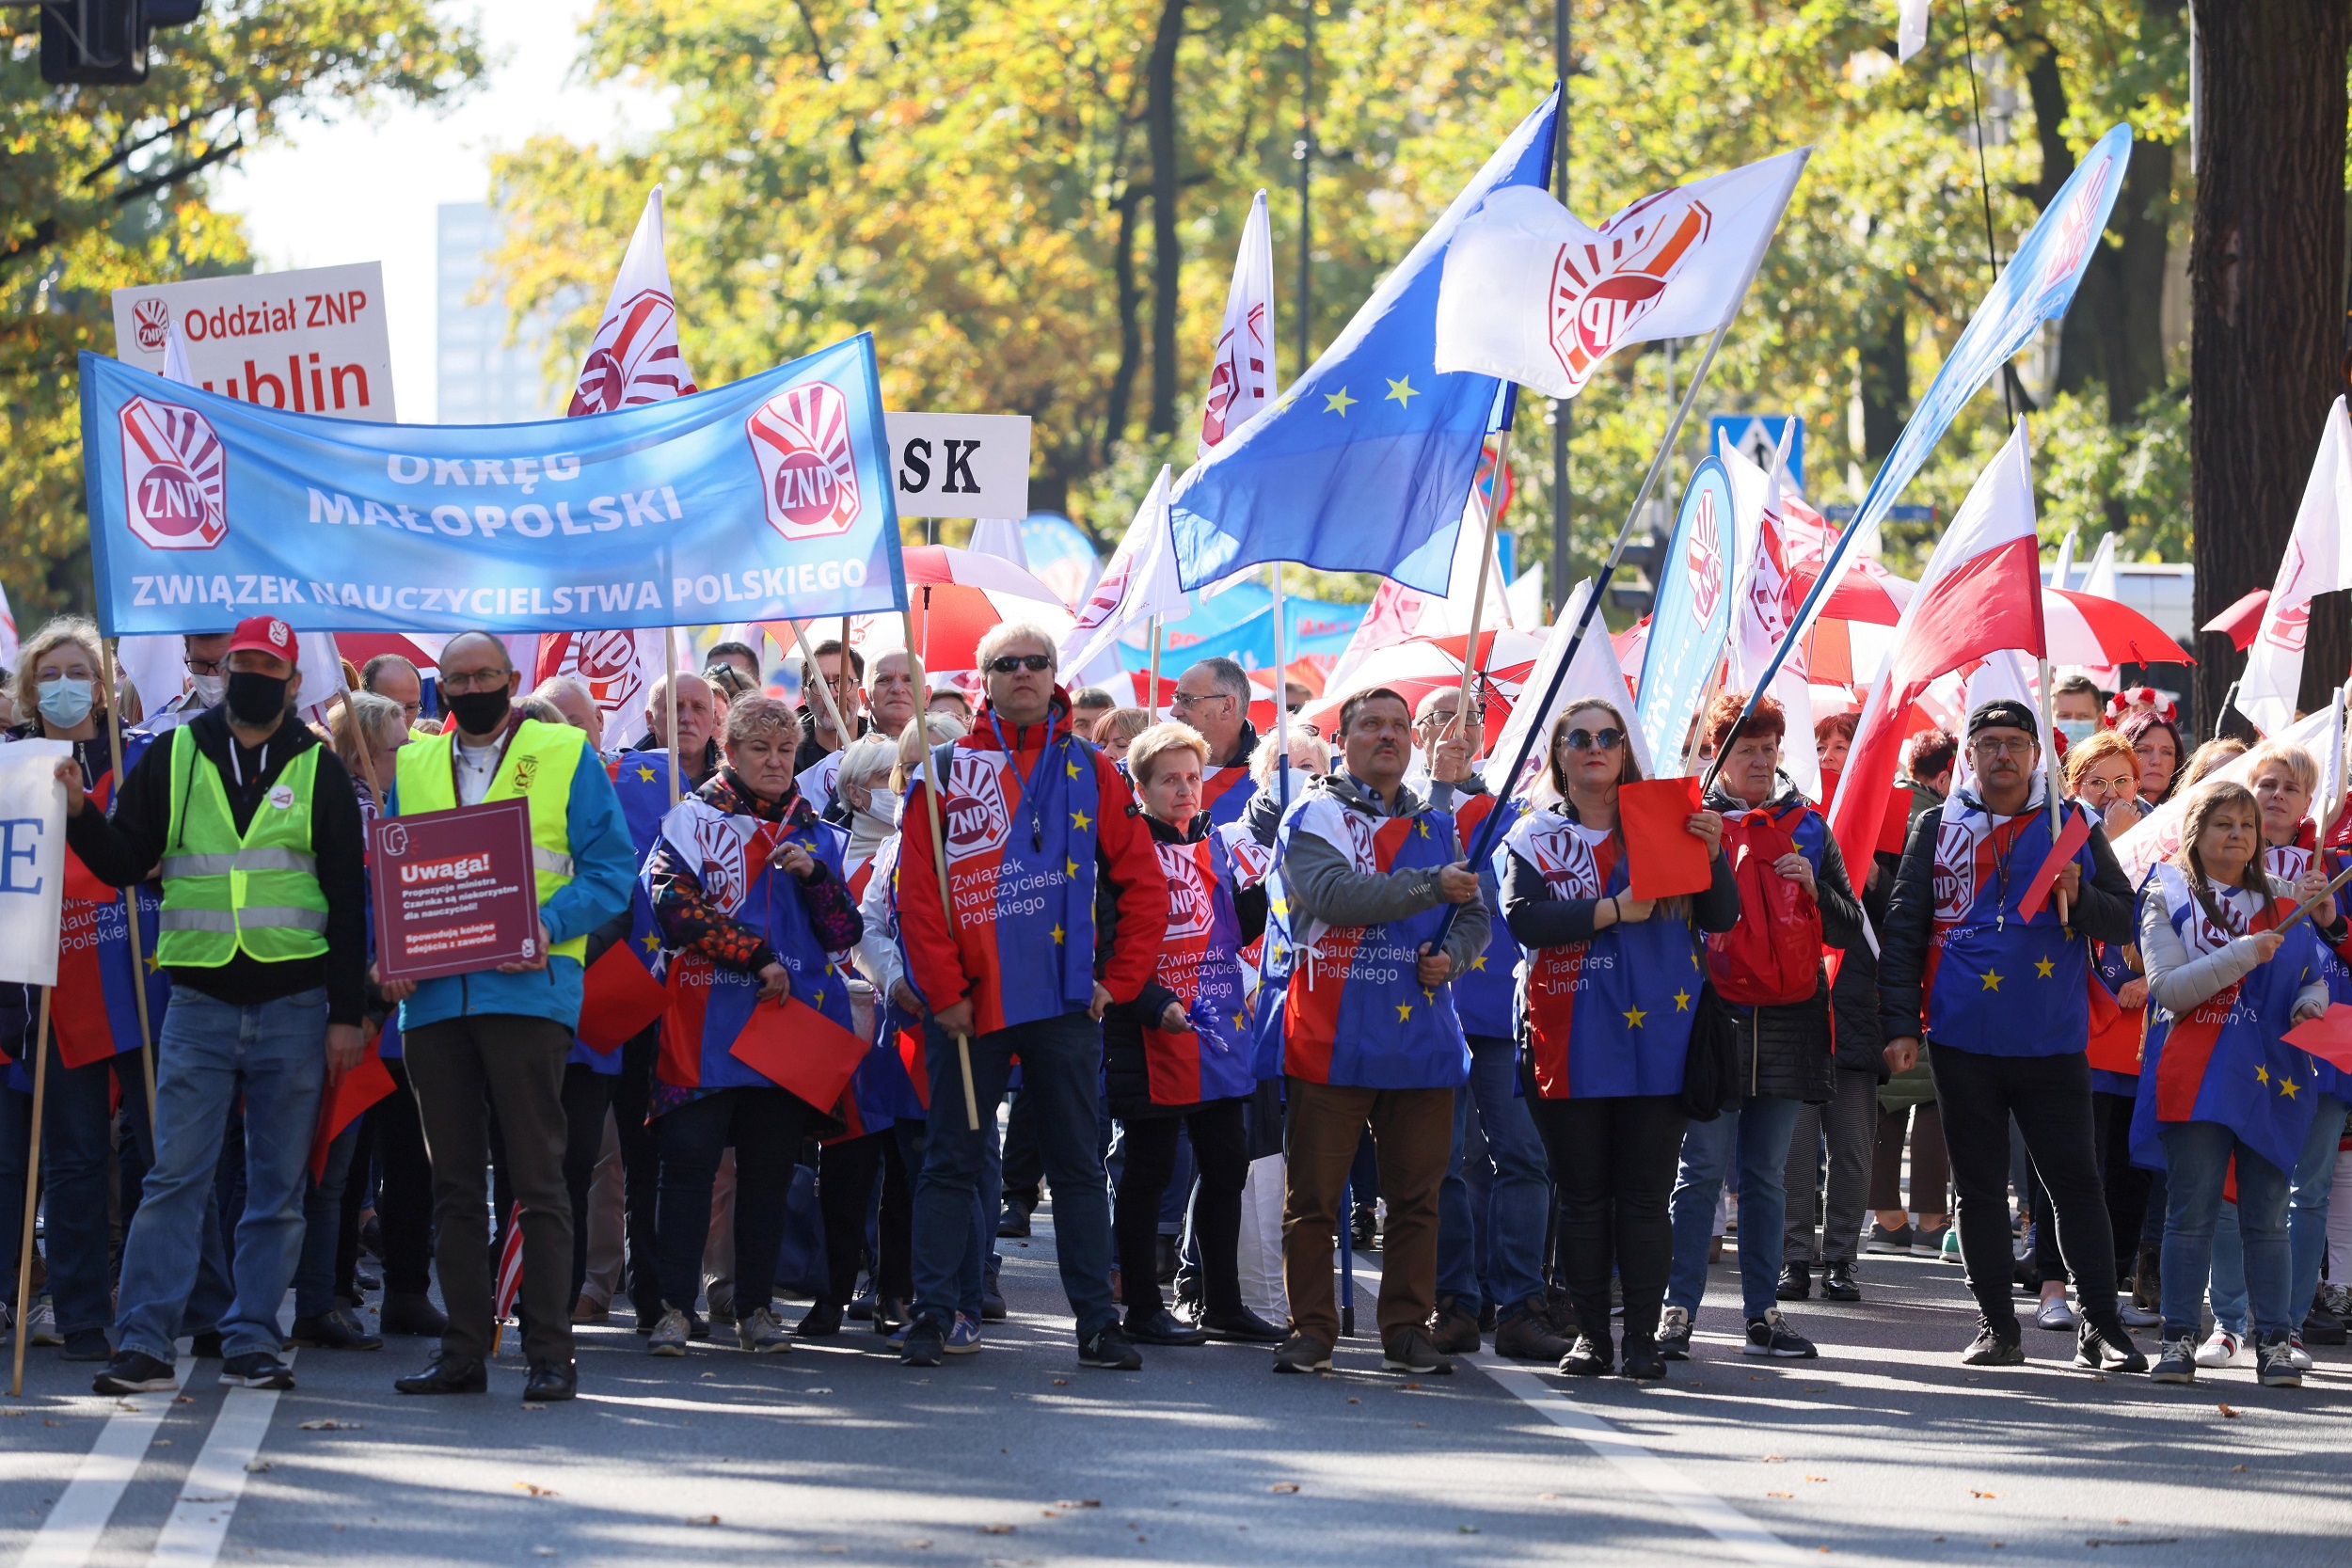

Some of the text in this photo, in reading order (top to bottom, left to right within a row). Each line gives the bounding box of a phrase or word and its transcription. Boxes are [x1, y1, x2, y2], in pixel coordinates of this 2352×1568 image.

[184, 291, 367, 342] Oddział ZNP
[141, 324, 165, 346] ZNP
[387, 451, 581, 495] OKRĘG
[888, 438, 982, 495] SK
[145, 477, 199, 518] ZNP
[780, 466, 833, 510] ZNP
[307, 485, 684, 538] MAŁOPOLSKI
[132, 558, 868, 615] ZWIĄZEK NAUCZYCIELSTWA POLSKIEGO
[947, 805, 988, 838] ZNP
[401, 853, 490, 882] Uwaga!
[950, 858, 1025, 893] Związek
[402, 877, 497, 898] Propozycje ministra
[403, 895, 443, 910] Czarnka
[458, 884, 519, 903] niekorzystne
[404, 910, 420, 921] dla
[960, 896, 1045, 929] Polskiego
[460, 922, 496, 936] kolejne
[1321, 925, 1387, 943] wiązek
[1317, 961, 1399, 985] Polskiego
[1545, 952, 1617, 975] Teachers'
[1546, 976, 1589, 995] Union
[2195, 1007, 2240, 1026] Union
